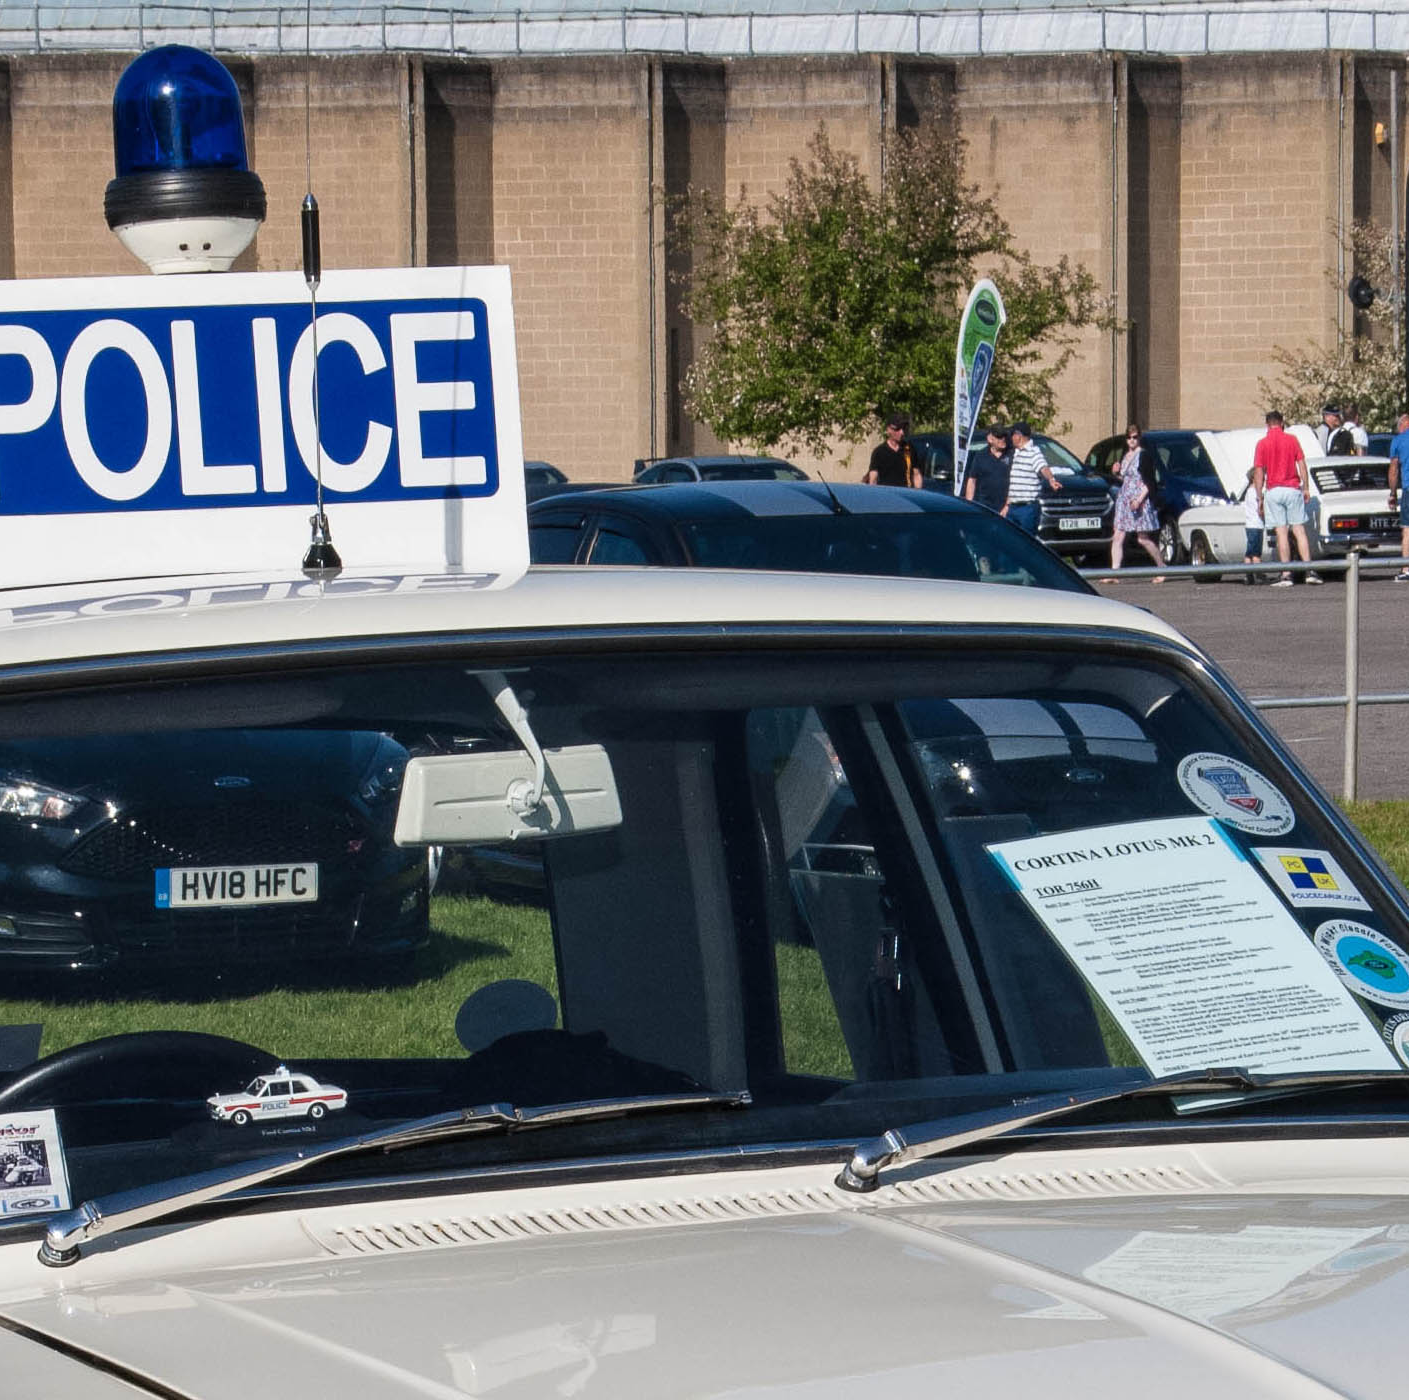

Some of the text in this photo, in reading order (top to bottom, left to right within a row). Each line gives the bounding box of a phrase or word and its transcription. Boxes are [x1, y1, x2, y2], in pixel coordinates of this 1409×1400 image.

[1014, 834, 1215, 872] CORTINA LOTUS MK 2
[181, 868, 307, 900] HV18 HFC
[1033, 885, 1066, 897] TOR
[1068, 879, 1101, 893] 756H
[262, 1103, 287, 1111] POLICE
